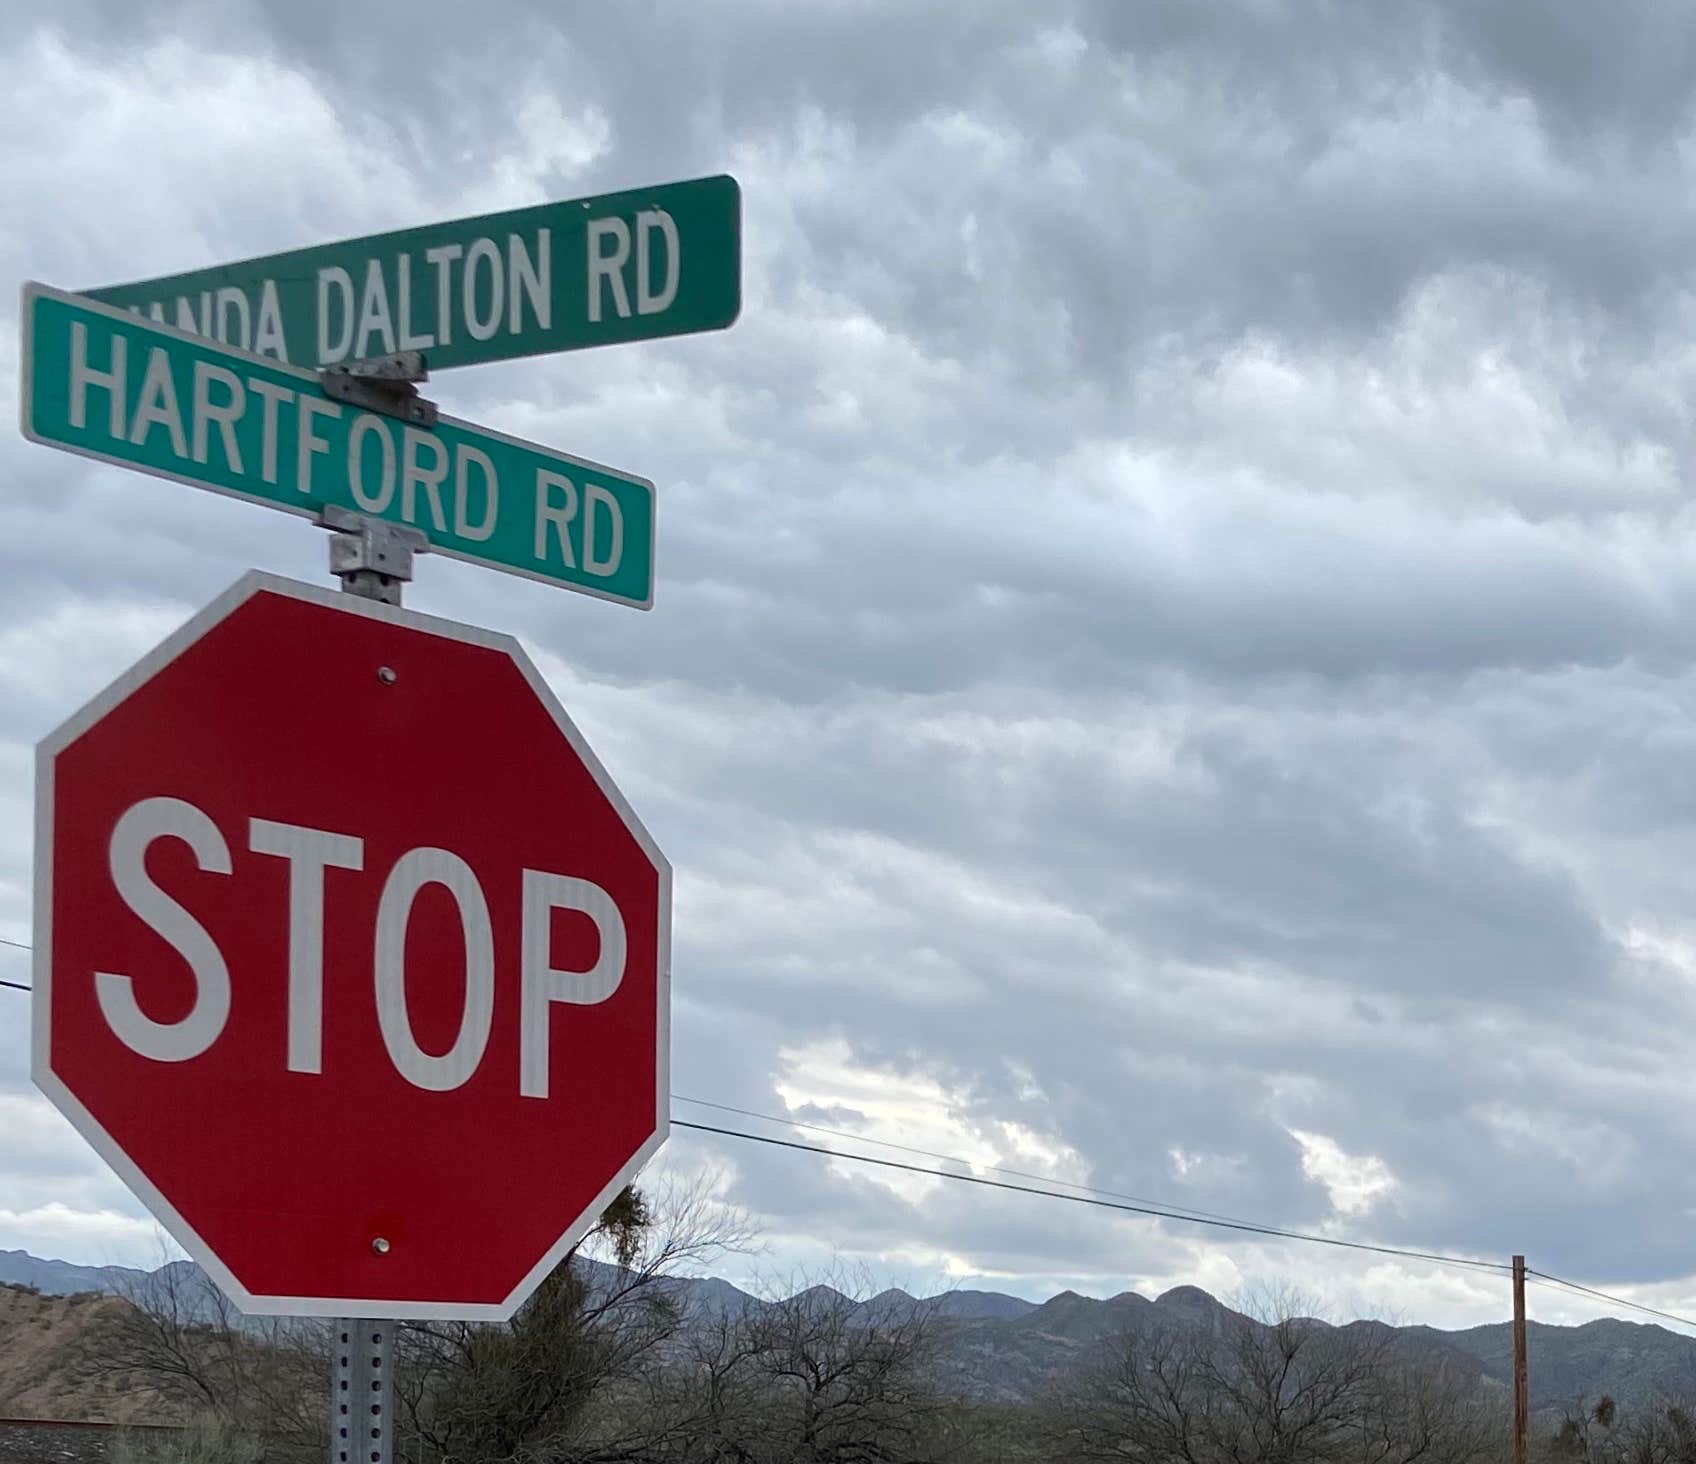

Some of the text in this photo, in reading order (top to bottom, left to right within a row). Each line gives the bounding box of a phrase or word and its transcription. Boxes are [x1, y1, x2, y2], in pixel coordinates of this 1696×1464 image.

[318, 227, 552, 365] DALTON
[587, 209, 681, 323] RD
[68, 322, 626, 578] HARTFORD RD
[95, 796, 628, 1099] STOP
